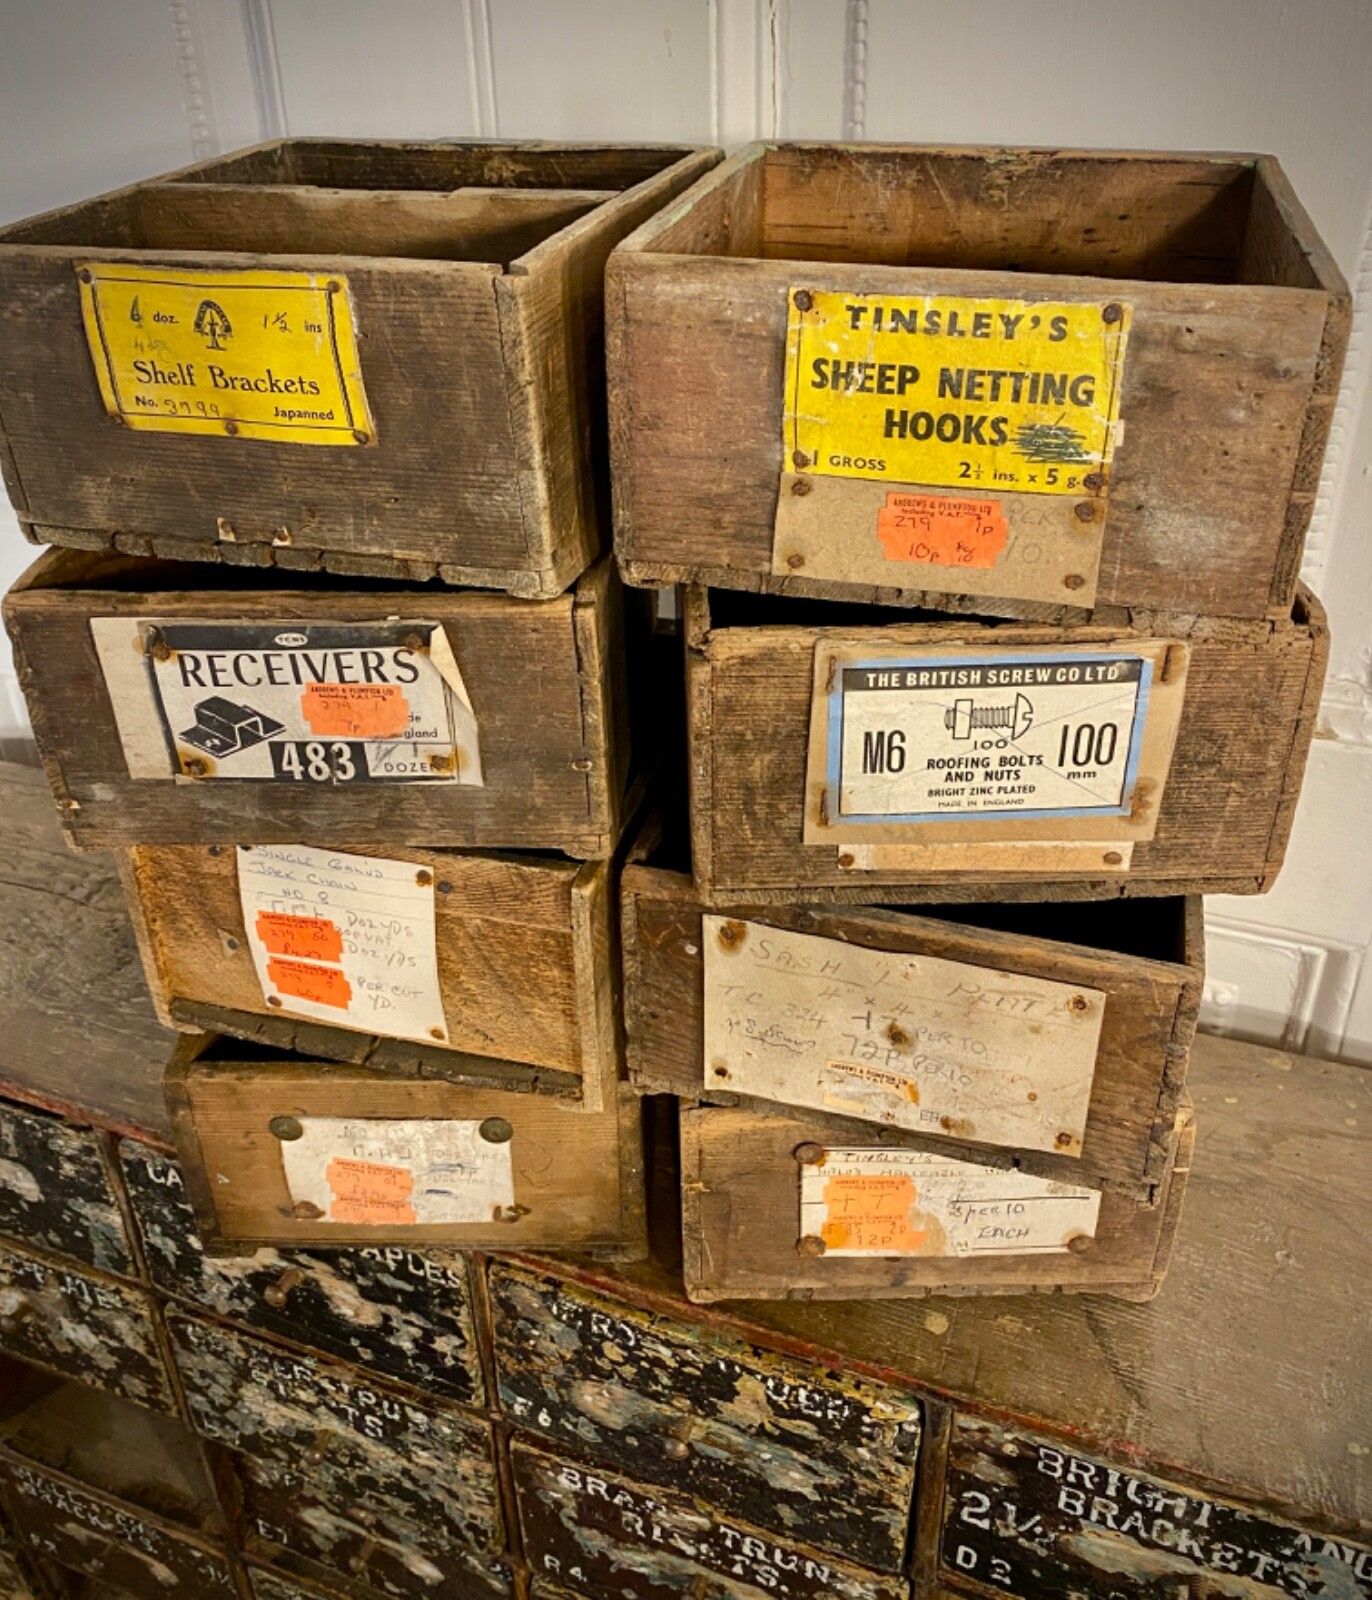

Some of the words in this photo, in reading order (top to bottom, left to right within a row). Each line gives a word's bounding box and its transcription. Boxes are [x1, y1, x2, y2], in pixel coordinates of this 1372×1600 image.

[153, 312, 179, 324] doz.
[846, 303, 1069, 342] TINSLEY'S
[132, 361, 196, 386] Shelf
[208, 365, 320, 396] Brackets
[811, 357, 920, 396] SHEEP
[938, 367, 1096, 407] NETTING
[135, 395, 159, 408] No.
[274, 406, 335, 421] Japanned
[883, 408, 1009, 447] HOOKS
[829, 455, 886, 472] GROSS
[993, 469, 1019, 483] ins.
[1046, 468, 1058, 485] 5
[177, 650, 420, 687] RECEIVERS
[867, 672, 900, 688] THE
[906, 670, 982, 688] BRITISH
[987, 668, 1051, 685] SCREW
[1056, 667, 1078, 683] CO
[1085, 666, 1119, 683] LTD
[408, 712, 422, 722] de
[404, 727, 438, 740] gland
[973, 739, 1008, 751] 100
[1057, 722, 1118, 768] 100
[281, 742, 357, 782] 483
[862, 730, 907, 775] M6
[926, 755, 990, 771] ROOFING
[999, 754, 1044, 768] BOLTS
[944, 770, 975, 783] AND
[983, 769, 1022, 783] NUTS
[1067, 771, 1097, 780] mm
[927, 787, 966, 798] BRIGHT
[969, 786, 994, 797] ZINC
[996, 785, 1036, 796] PLATED
[938, 801, 963, 809] MADE
[967, 800, 979, 808] IN
[983, 799, 1025, 807] ENGLAND
